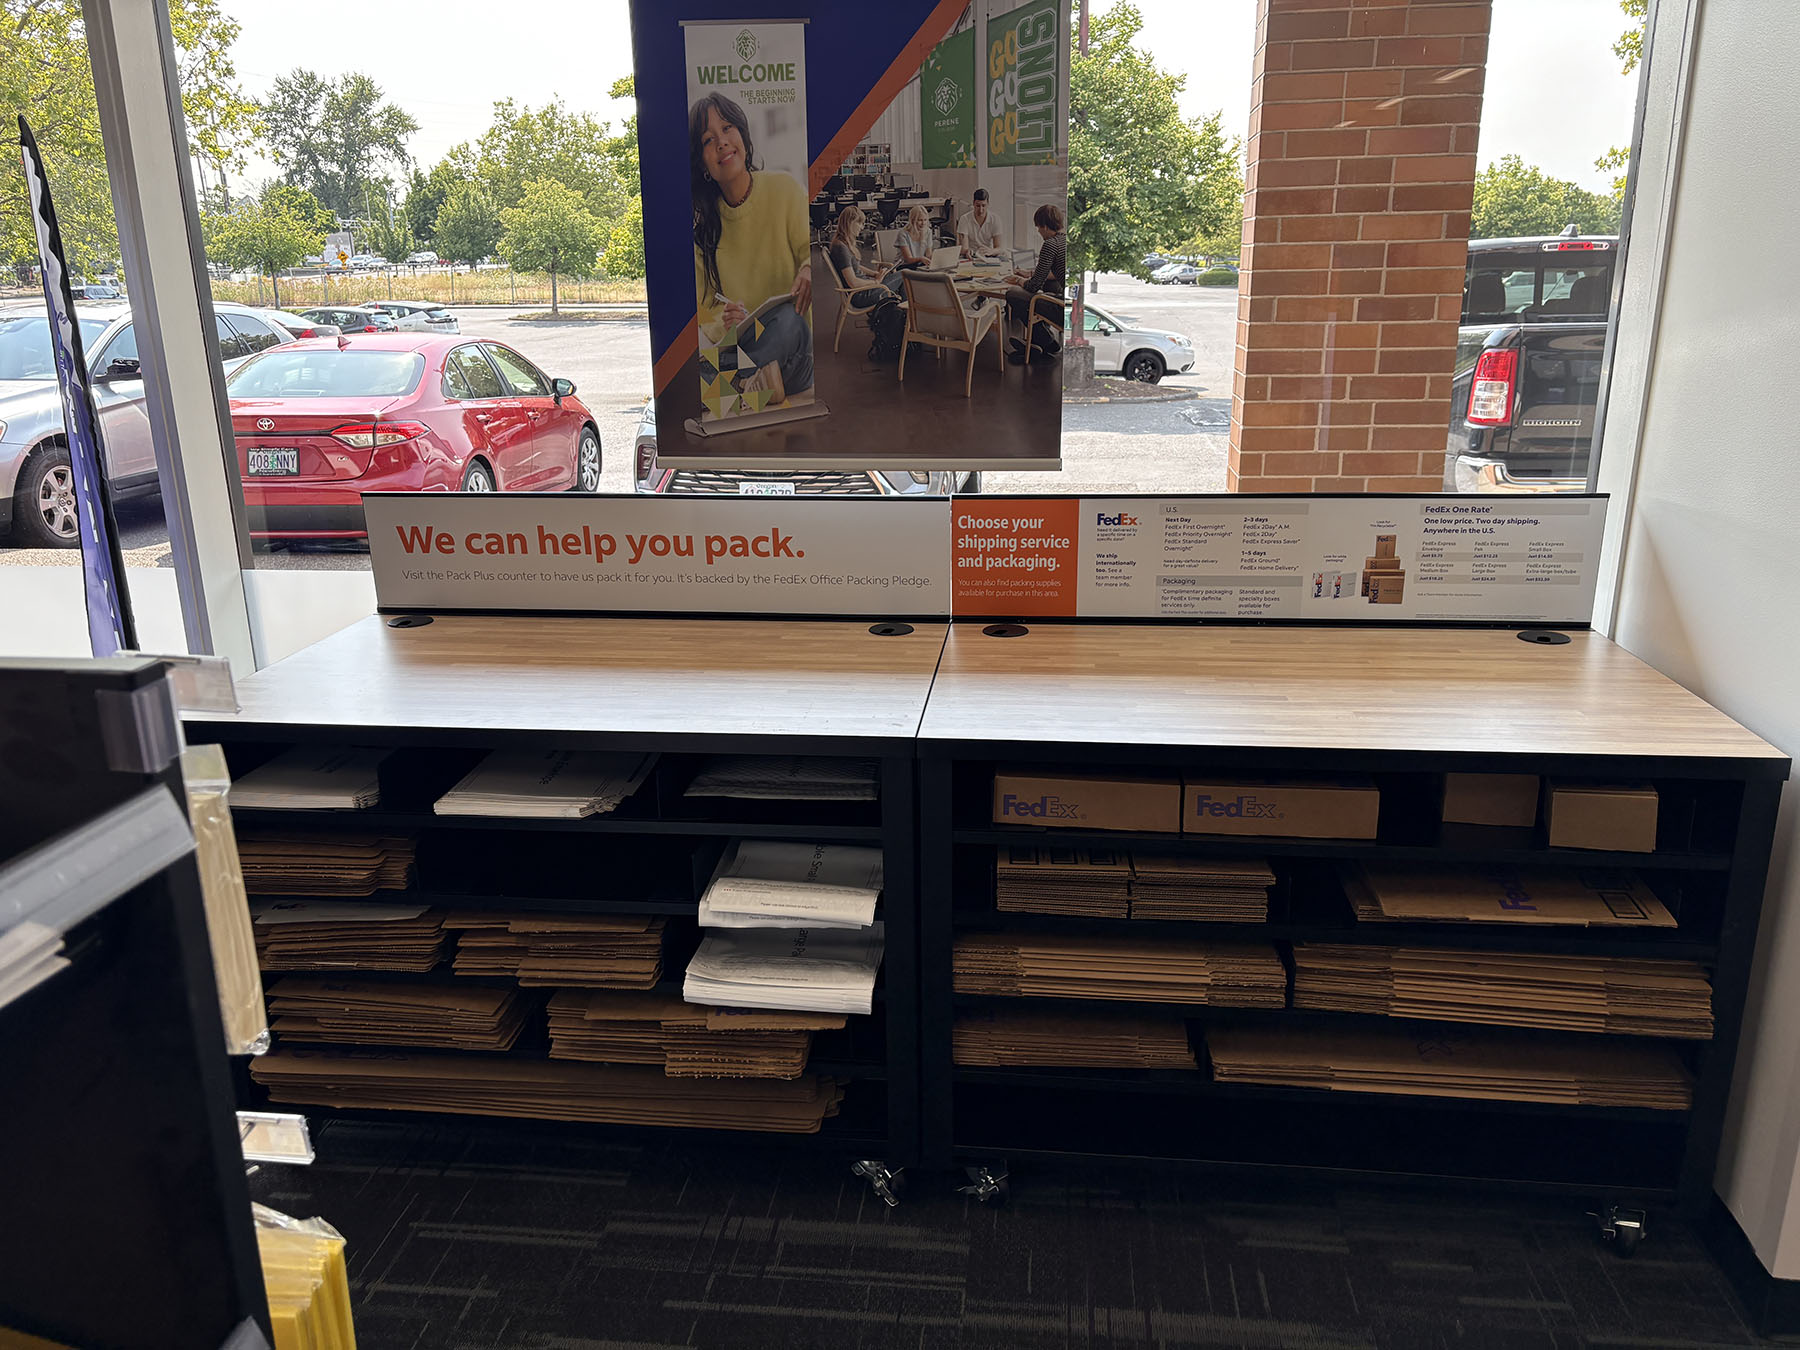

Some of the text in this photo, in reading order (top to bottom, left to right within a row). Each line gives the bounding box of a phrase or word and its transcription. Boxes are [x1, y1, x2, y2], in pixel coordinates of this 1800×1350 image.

[989, 30, 1018, 79] GO
[697, 63, 796, 85] WELCOME
[1016, 7, 1057, 154] LIONS
[740, 88, 796, 98] THE BEGINNING
[777, 96, 796, 104] NOW
[989, 70, 1018, 117] GO
[990, 111, 1020, 155] GO
[250, 454, 296, 468] 408 NNY
[958, 515, 1044, 532] Choose your
[1454, 518, 1474, 526] price.
[1492, 518, 1506, 526] day
[1506, 518, 1540, 526] shipping.
[396, 524, 805, 565] We can help you pack.
[958, 534, 1070, 552] shipping service
[958, 554, 1060, 572] and packaging.
[402, 570, 424, 581] Visit
[426, 570, 444, 581] the
[446, 570, 472, 581] Pack
[474, 570, 495, 582] Plus
[497, 572, 537, 582] counter
[540, 572, 552, 582] to
[554, 570, 579, 582] have
[581, 573, 594, 582] us
[596, 572, 622, 584] pack
[624, 572, 632, 582] it
[634, 571, 650, 582] for
[652, 575, 674, 585] you.
[677, 573, 692, 584] It's
[694, 573, 734, 584] backed
[736, 574, 750, 586] by
[752, 574, 770, 584] the
[773, 574, 807, 585] FedEx
[846, 575, 889, 588] Packing
[892, 576, 932, 588] Pledge.
[1010, 580, 1034, 588] packing
[1036, 580, 1061, 588] supplies
[1162, 578, 1196, 586] Packaging
[958, 588, 984, 597] available
[986, 588, 994, 596] for
[996, 589, 1025, 598] purchase
[1032, 589, 1043, 597] this
